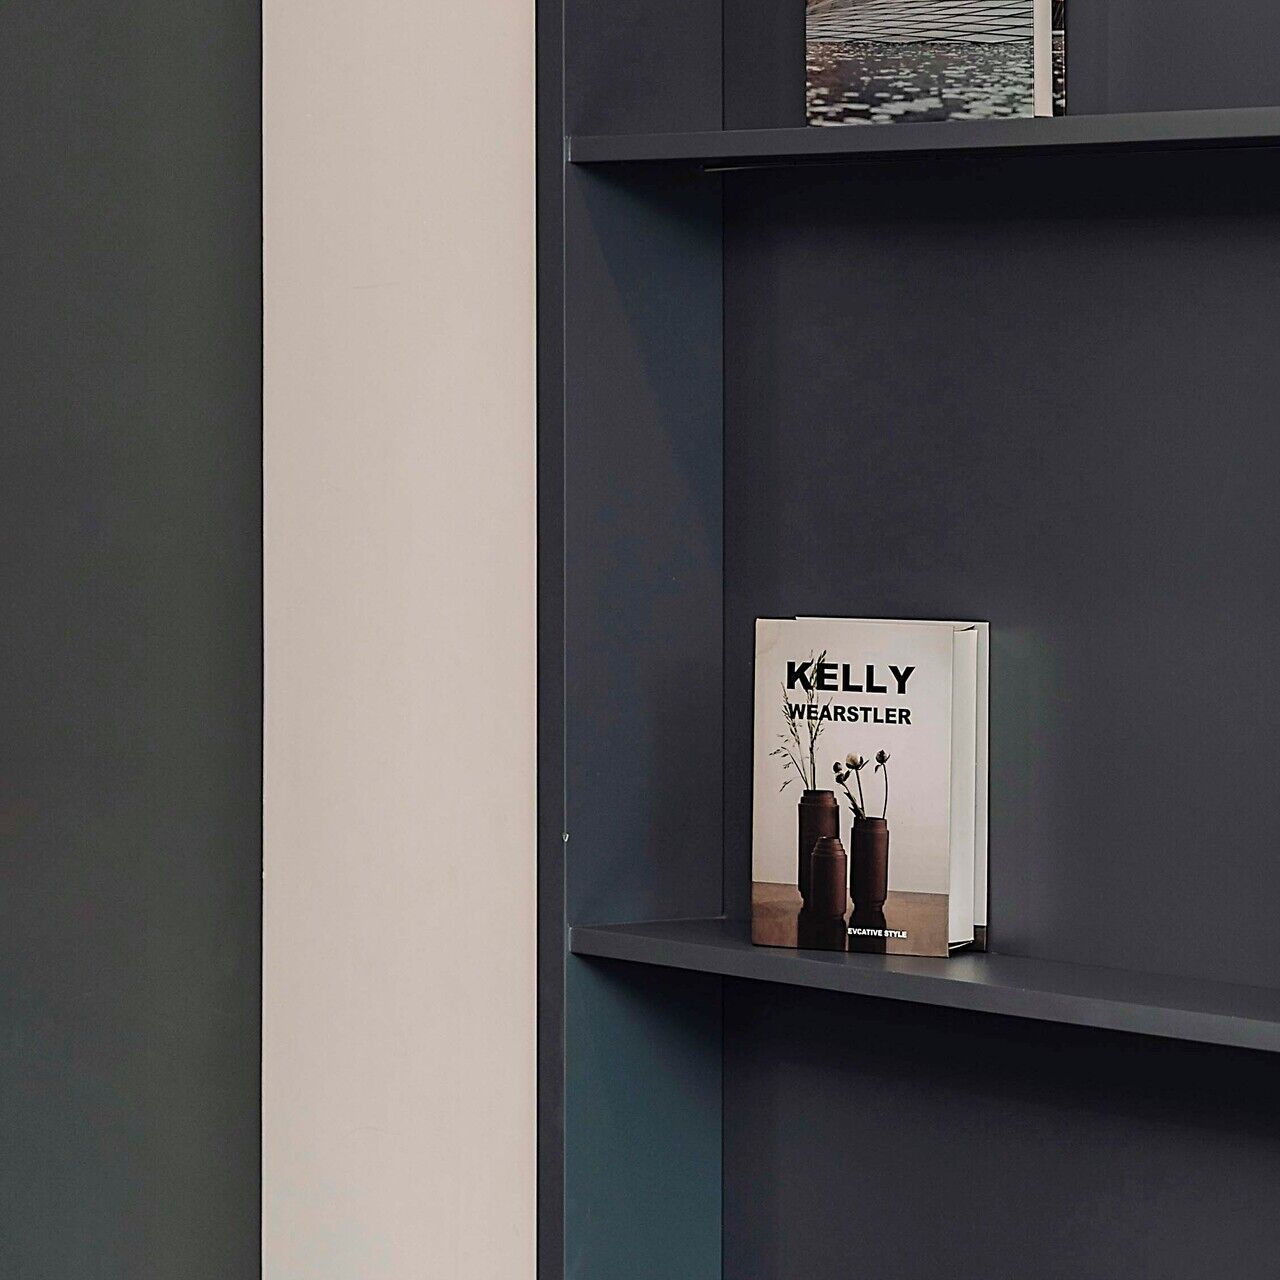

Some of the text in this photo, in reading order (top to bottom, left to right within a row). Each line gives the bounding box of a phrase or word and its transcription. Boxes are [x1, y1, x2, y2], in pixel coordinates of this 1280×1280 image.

[786, 661, 916, 695] KELLY
[788, 703, 912, 725] WEARSTLER
[883, 929, 908, 939] STYLE
